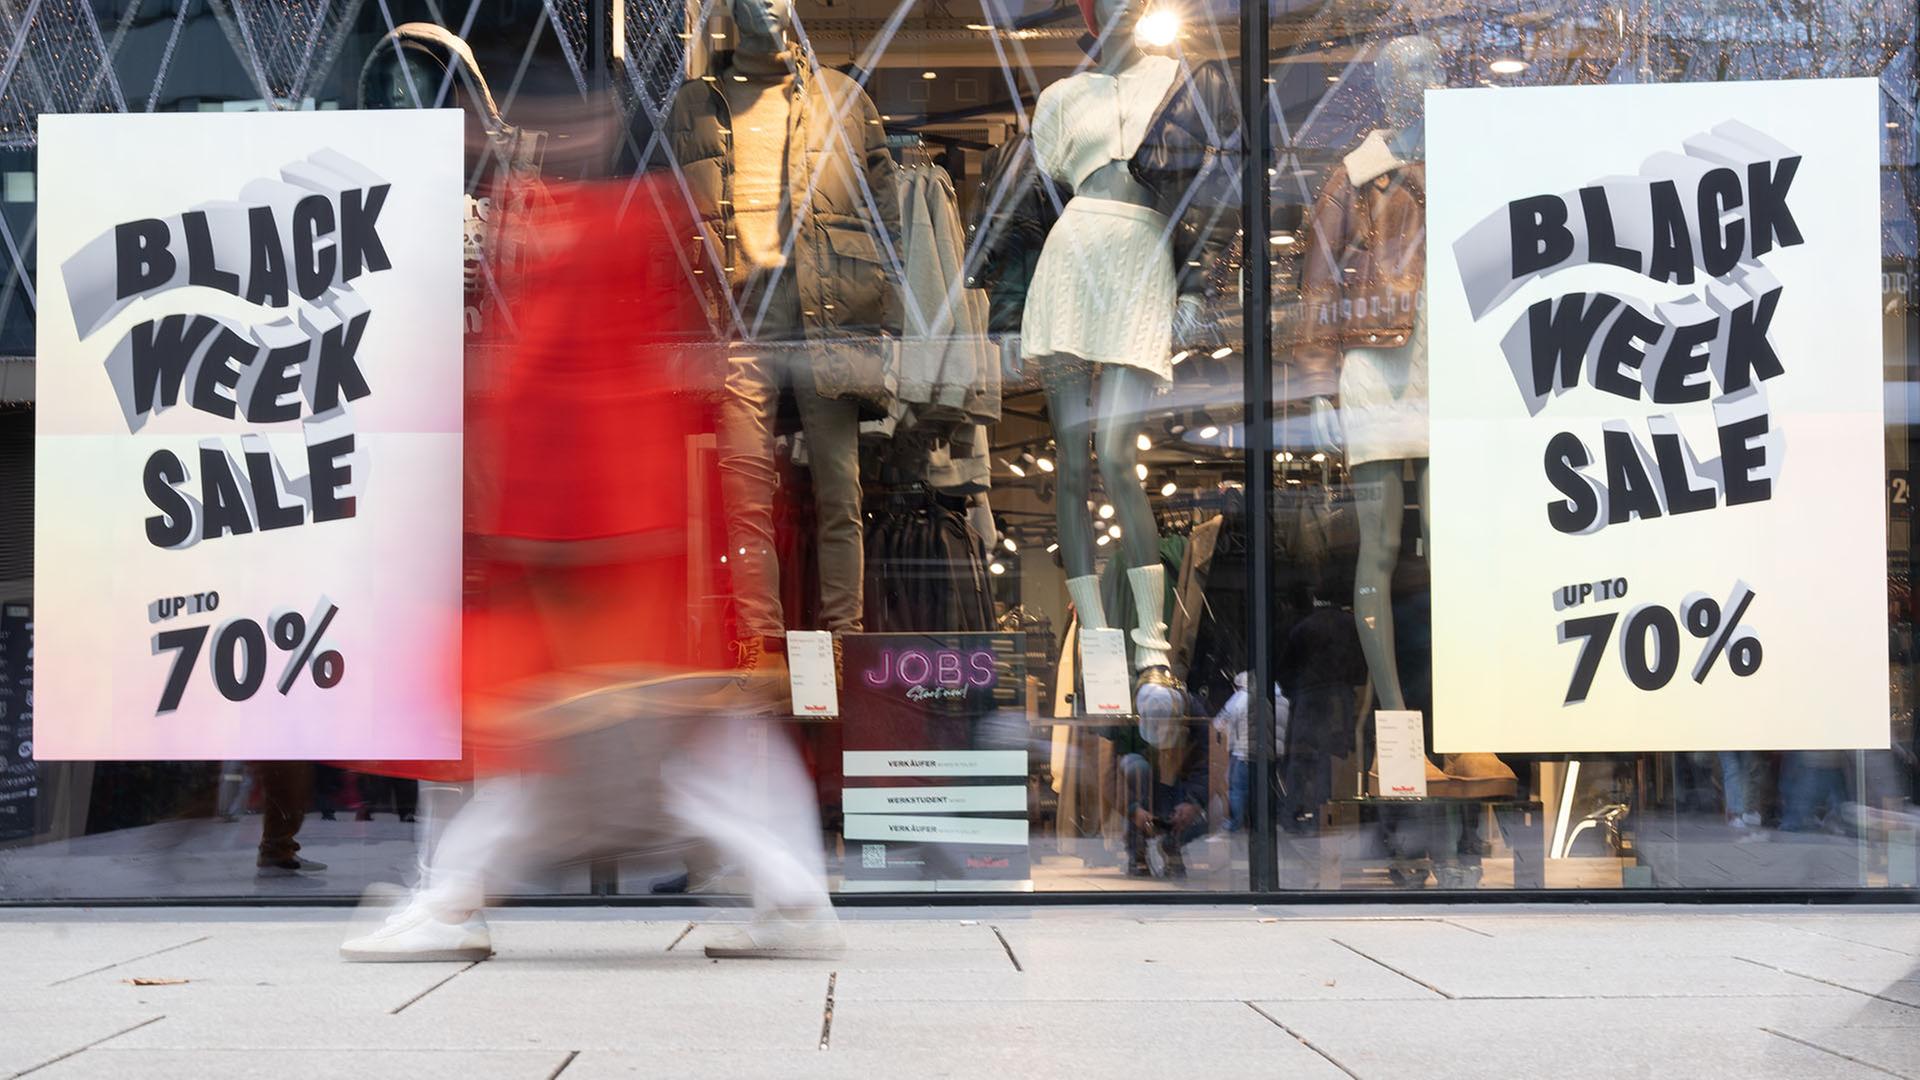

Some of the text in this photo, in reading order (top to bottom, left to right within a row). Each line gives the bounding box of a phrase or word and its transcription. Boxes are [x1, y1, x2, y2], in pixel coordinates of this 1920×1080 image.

[115, 184, 392, 308] BLACK
[1509, 156, 1804, 285] BLACK
[131, 310, 371, 423] WEEK
[1528, 286, 1785, 404] WEEK
[143, 434, 356, 549] SALE
[1544, 414, 1771, 534] SALE
[158, 591, 220, 619] UP TO
[1562, 588, 1763, 704] 70%
[1563, 577, 1628, 606] UP TO
[155, 604, 345, 714] 70%
[866, 650, 994, 686] JOBS
[887, 796, 947, 804] WERKSTUDENT
